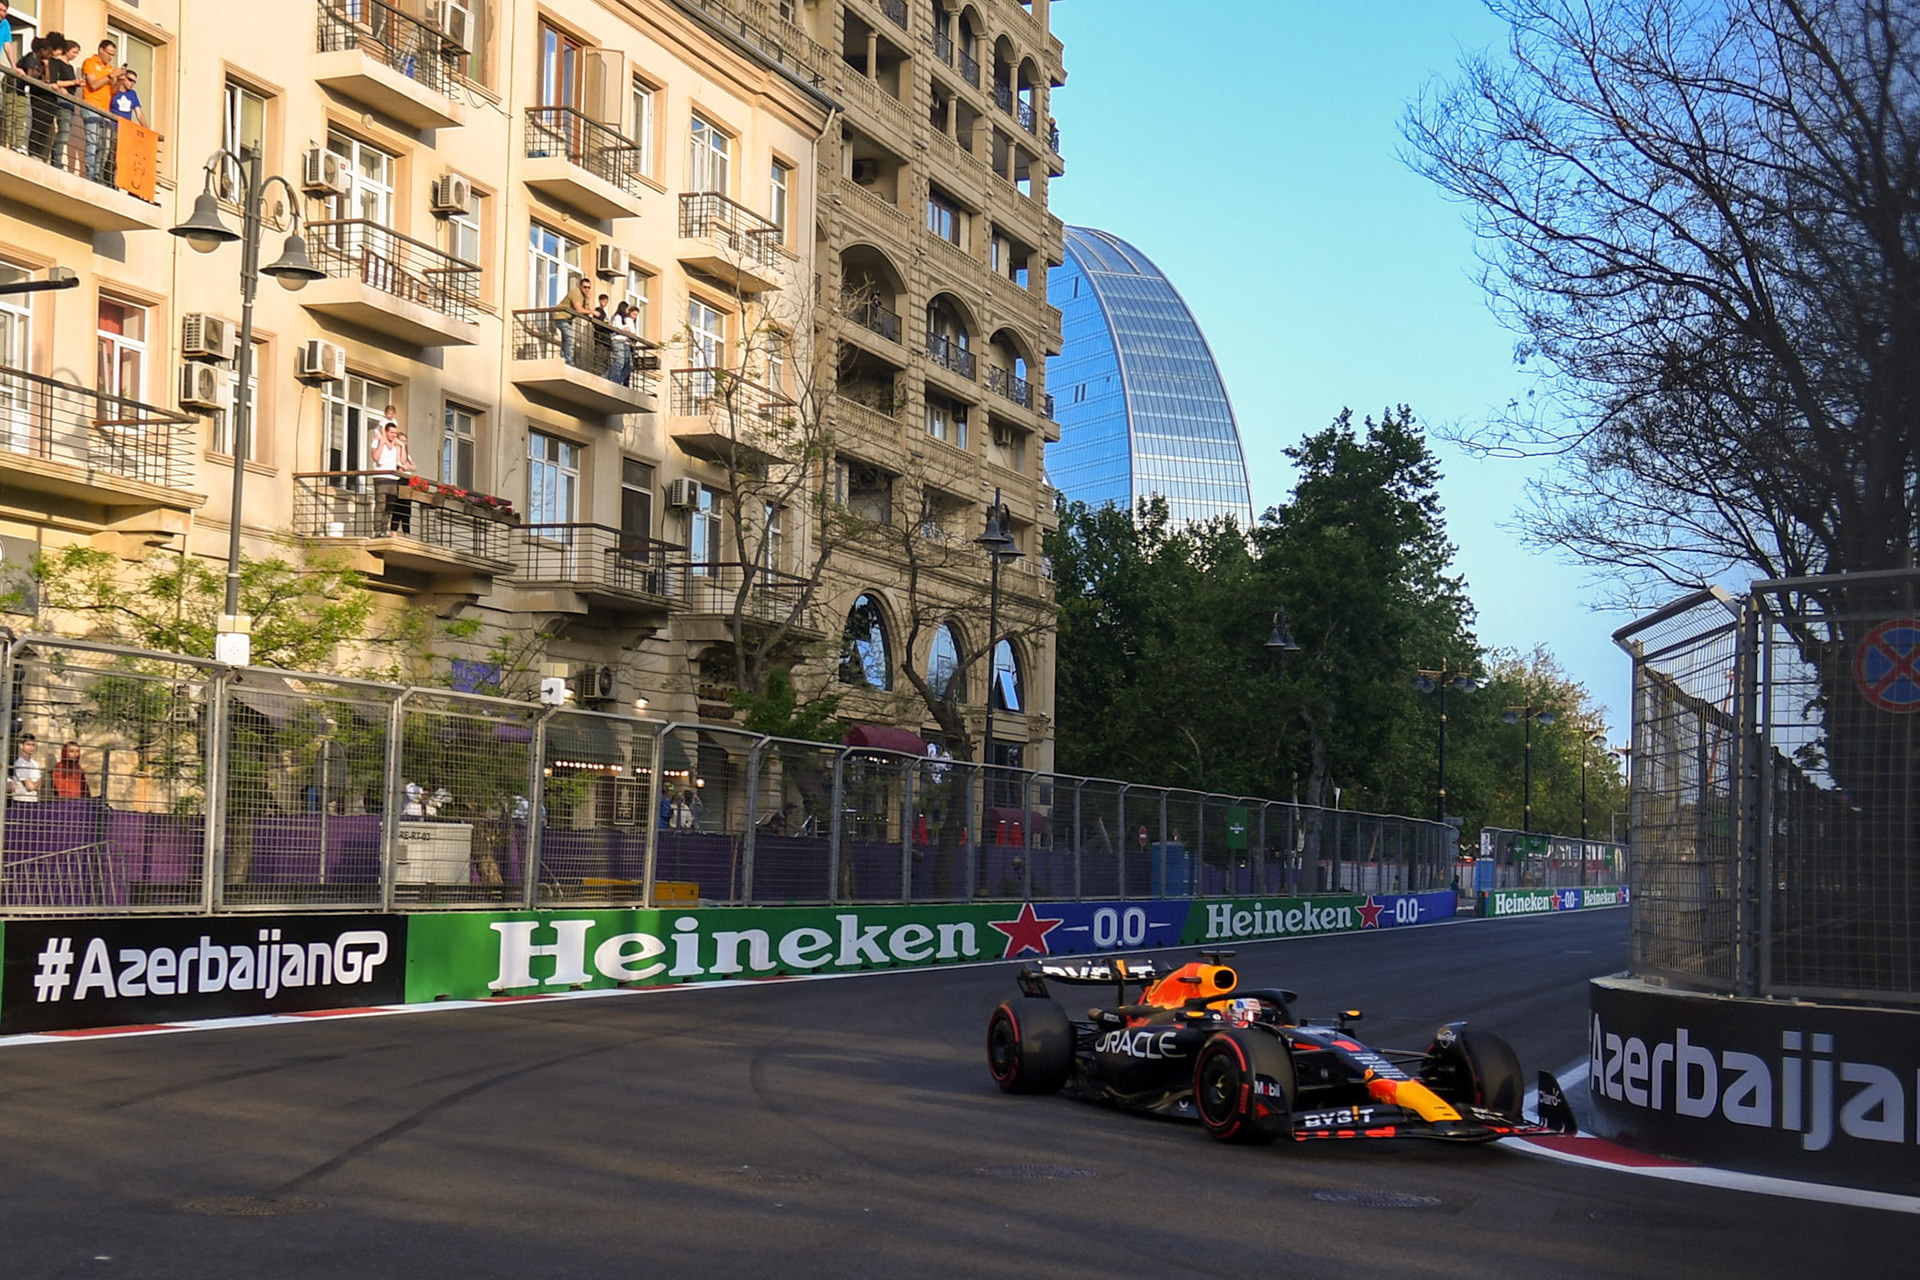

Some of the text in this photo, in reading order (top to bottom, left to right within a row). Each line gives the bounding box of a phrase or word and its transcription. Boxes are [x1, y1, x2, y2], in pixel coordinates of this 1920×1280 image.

[1494, 892, 1550, 915] Heineken
[1583, 889, 1617, 907] Heineken
[1205, 901, 1353, 939] Heineken
[34, 928, 388, 1003] #AzerbaijanGP
[488, 914, 980, 990] Heineken
[1095, 1029, 1188, 1059] ORACLE
[1254, 1080, 1281, 1098] Mobil
[1591, 1012, 1920, 1151] Azerbaija
